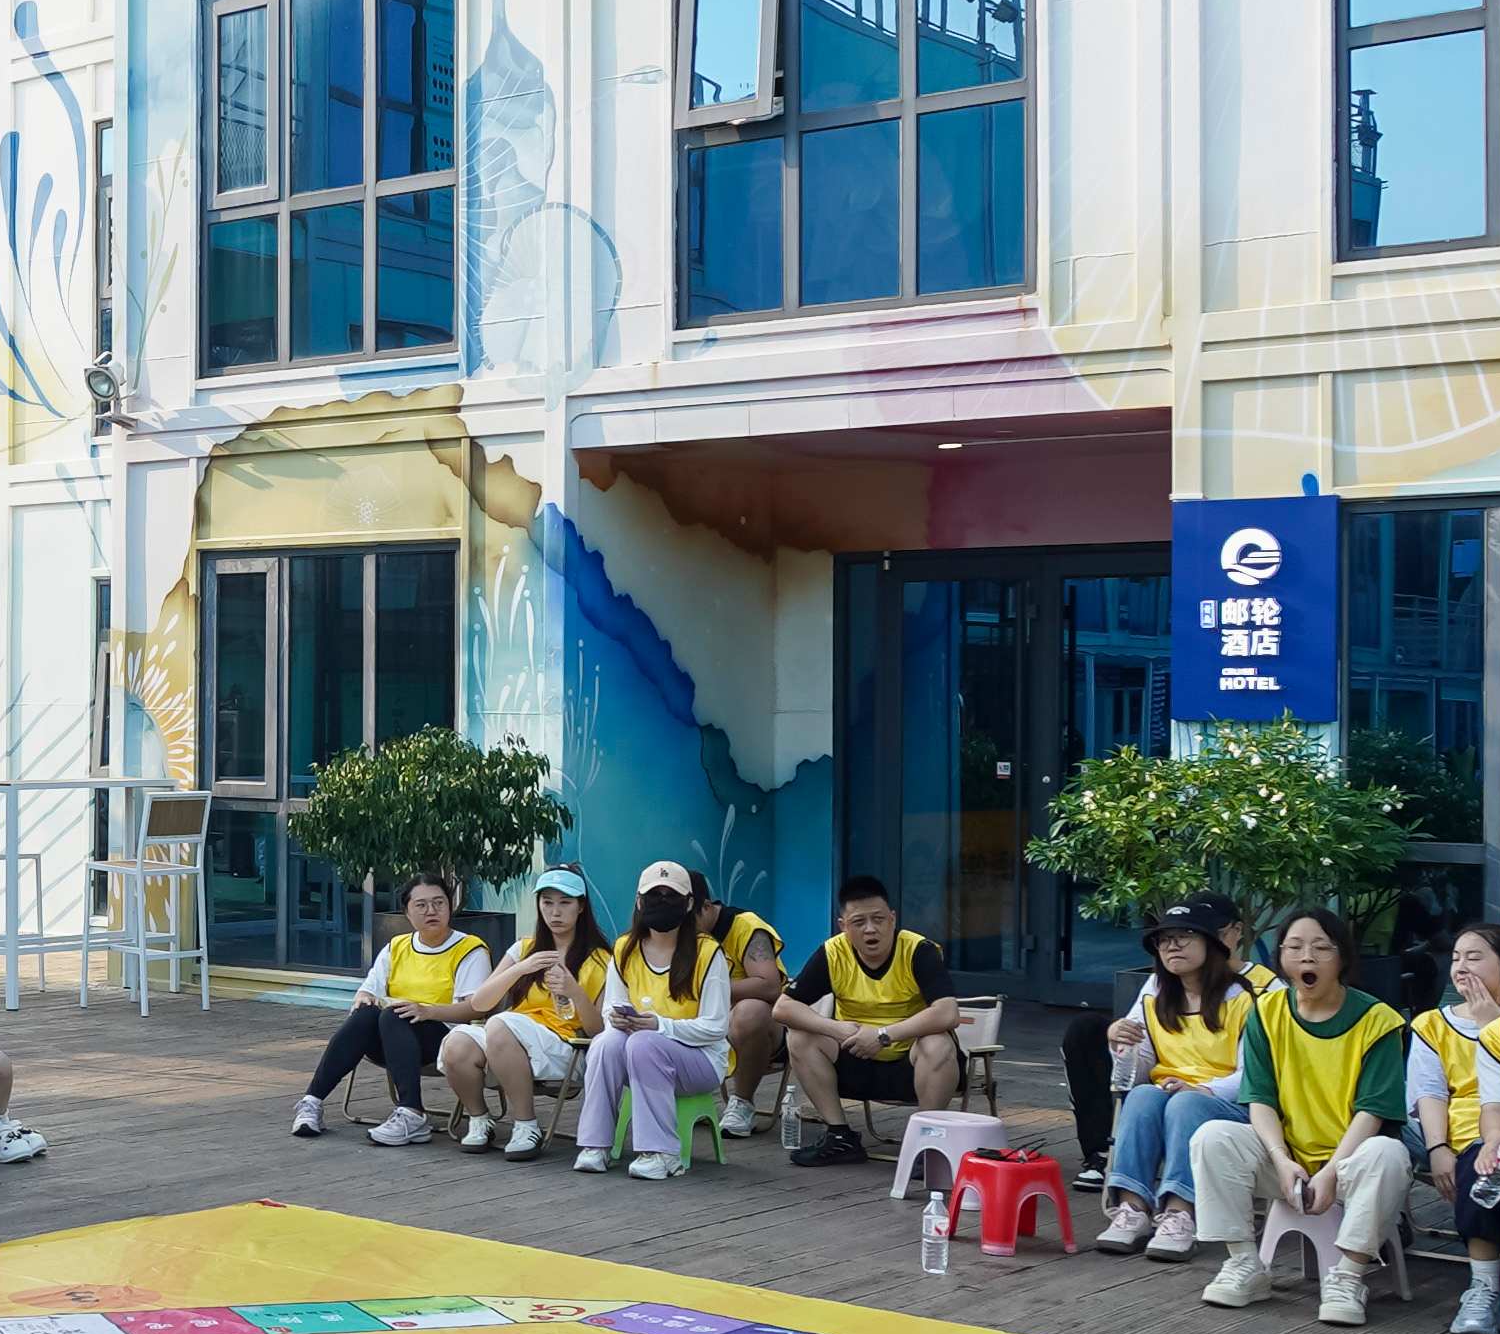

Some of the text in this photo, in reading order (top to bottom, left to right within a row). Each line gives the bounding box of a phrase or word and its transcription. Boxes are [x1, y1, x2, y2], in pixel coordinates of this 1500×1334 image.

[1221, 597, 1281, 625] 邮轮
[1221, 628, 1281, 656] 酒店
[1219, 677, 1281, 690] HOTEL
